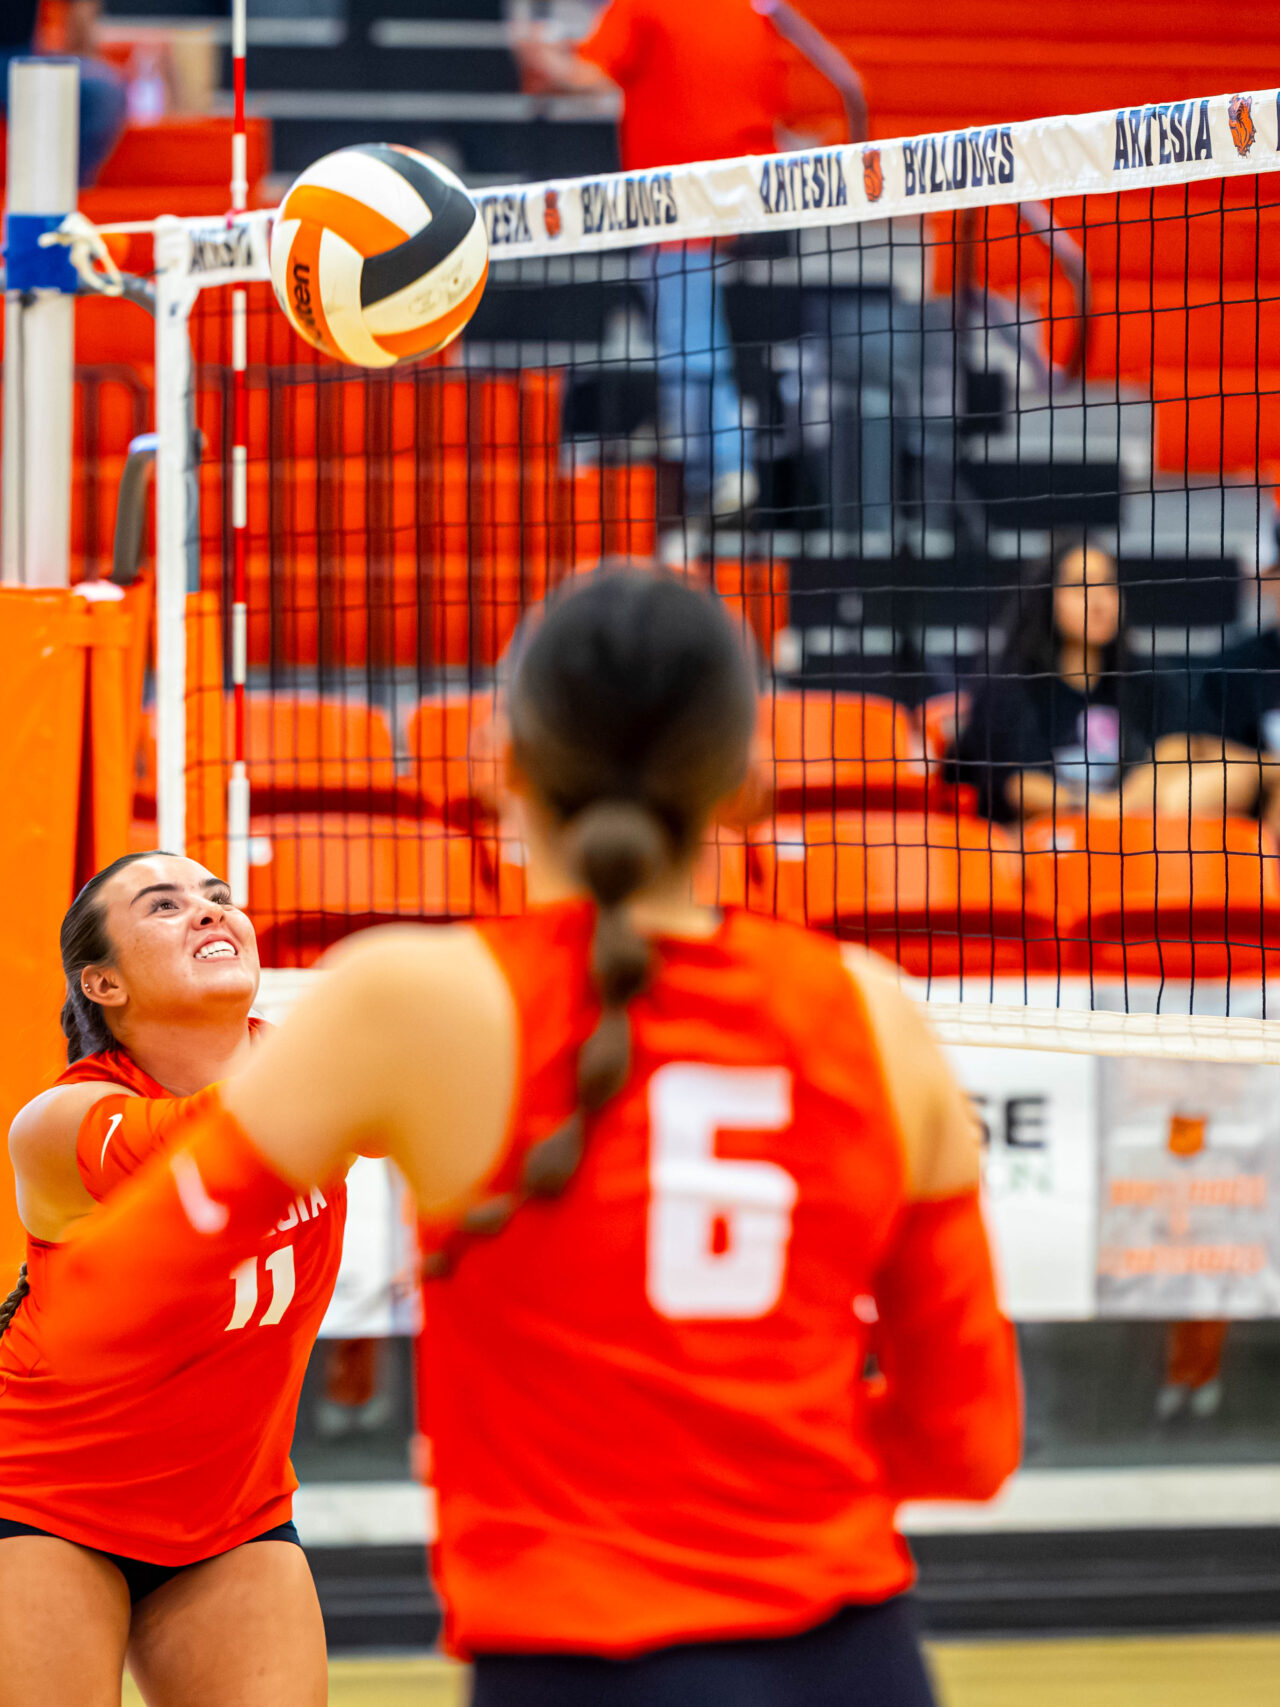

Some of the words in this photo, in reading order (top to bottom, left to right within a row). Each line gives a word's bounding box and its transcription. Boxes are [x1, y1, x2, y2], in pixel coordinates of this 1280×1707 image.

[759, 152, 847, 214] ARTESIA
[902, 127, 1014, 196] BULLDOGS
[1113, 99, 1213, 170] ARTESIA
[646, 1062, 798, 1320] 6
[224, 1245, 296, 1331] 11
